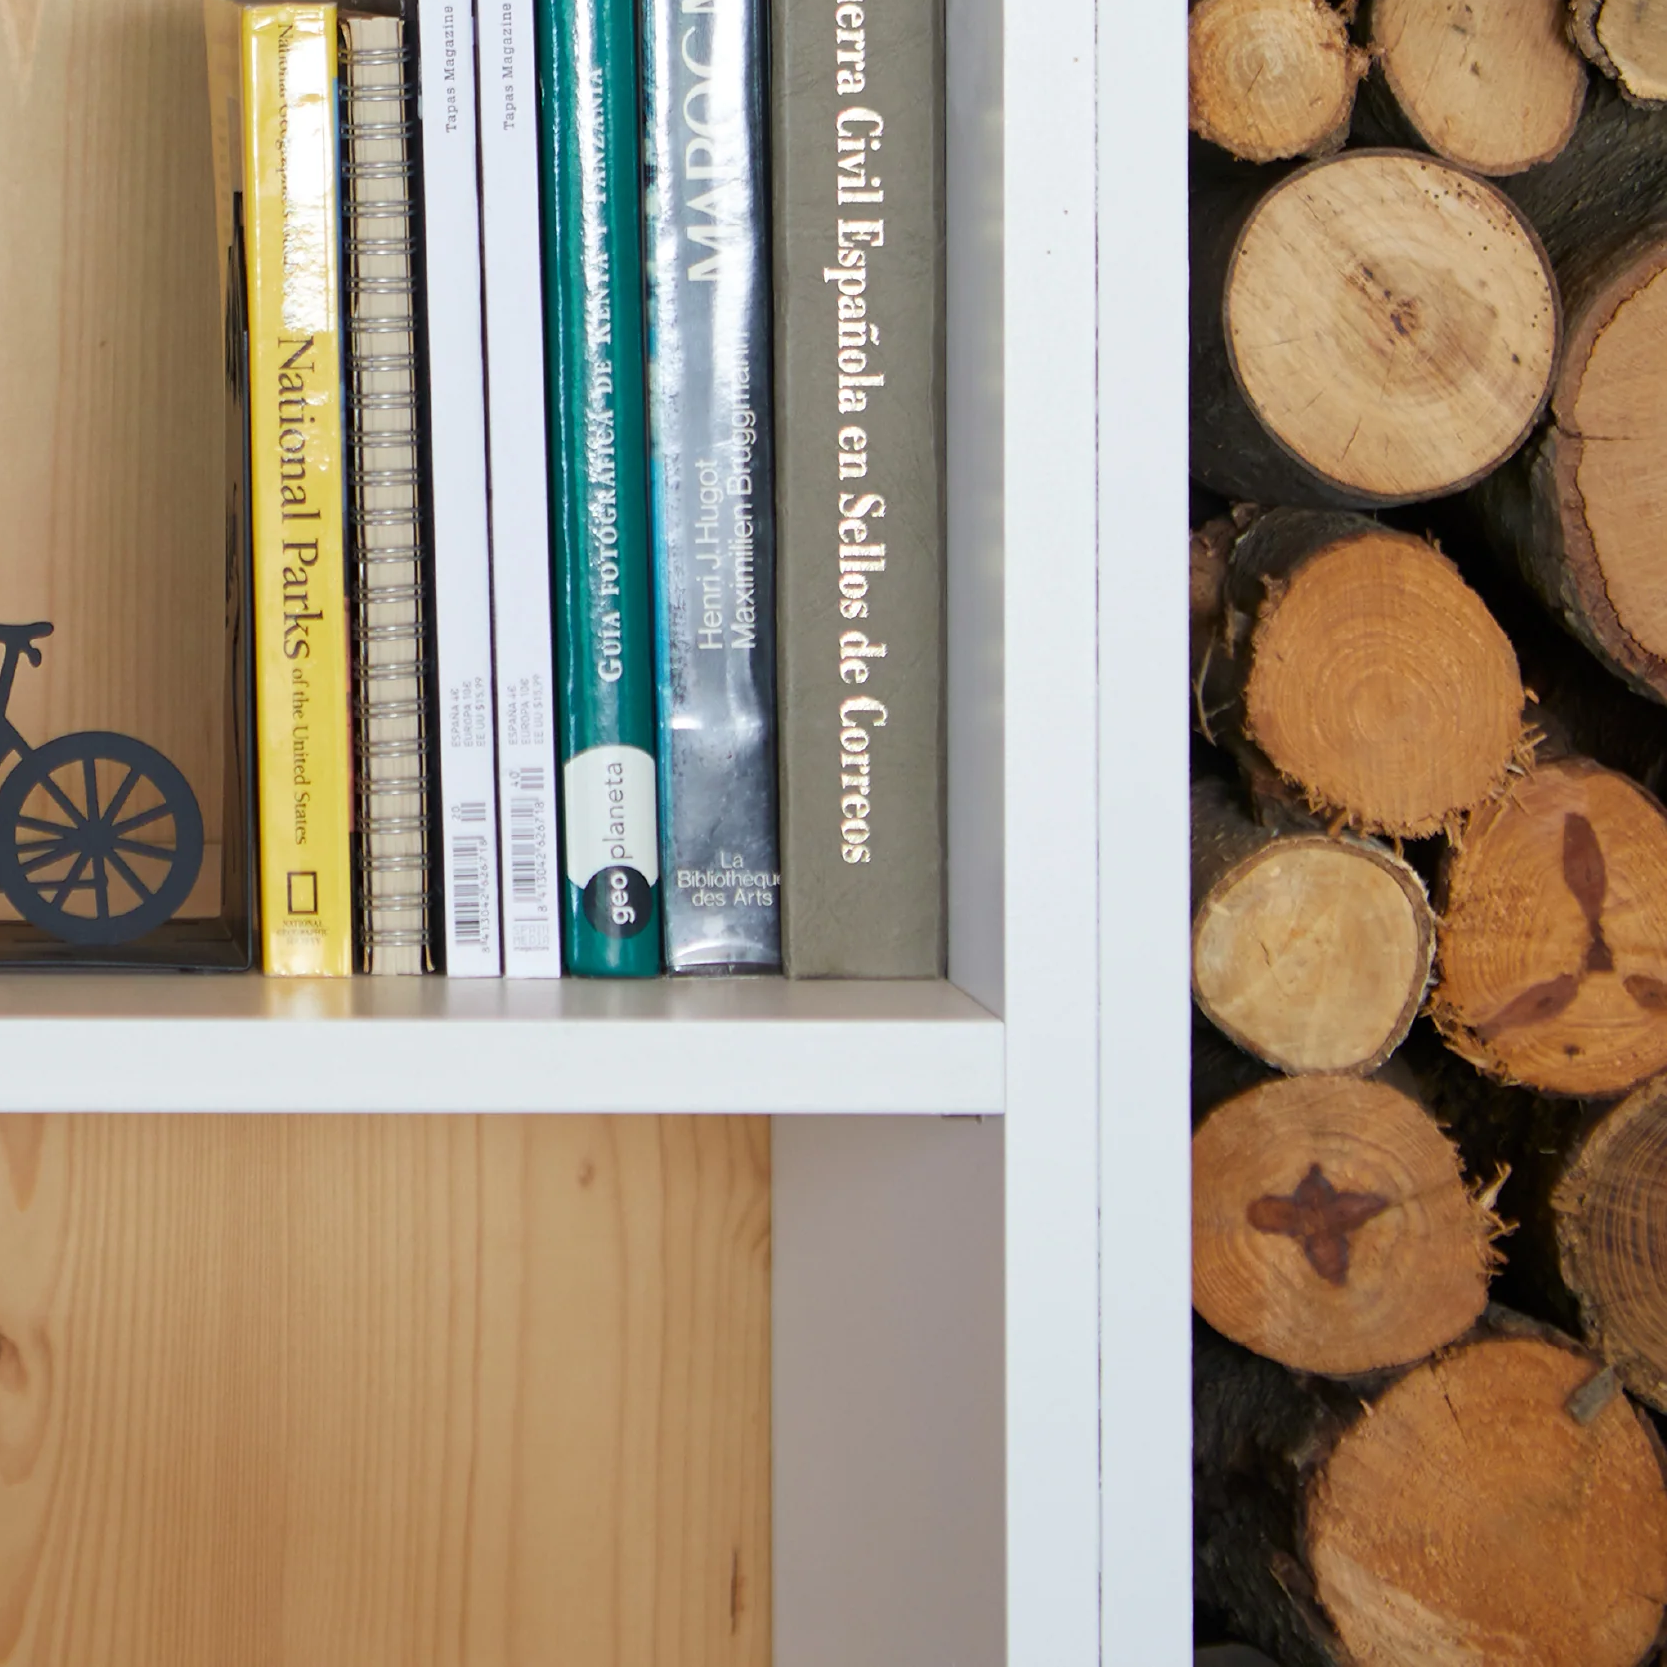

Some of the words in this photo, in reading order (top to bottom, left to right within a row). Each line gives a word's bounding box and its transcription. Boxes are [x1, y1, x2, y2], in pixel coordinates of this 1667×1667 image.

[441, 4, 456, 80] Magazine
[499, 2, 514, 78] Magazine
[444, 86, 458, 132] Tapas
[502, 84, 515, 130] Tapas
[681, 24, 742, 280] MAROC
[835, 106, 884, 205] Civil
[824, 218, 884, 413] Española
[275, 336, 320, 522] National
[723, 330, 758, 494] Bruggmann
[835, 425, 871, 479] en
[694, 458, 723, 543] Hugot
[728, 502, 756, 649] Maximilien
[836, 492, 886, 617] Sellos
[280, 538, 322, 660] Parks
[696, 575, 723, 649] Henri
[291, 669, 307, 686] of
[838, 629, 886, 682] de
[291, 690, 308, 721] the
[291, 724, 309, 785] United
[838, 695, 887, 863] Correos
[293, 791, 310, 845] States
[692, 889, 726, 907] des
[734, 888, 773, 906] Arts
[720, 851, 743, 869] La
